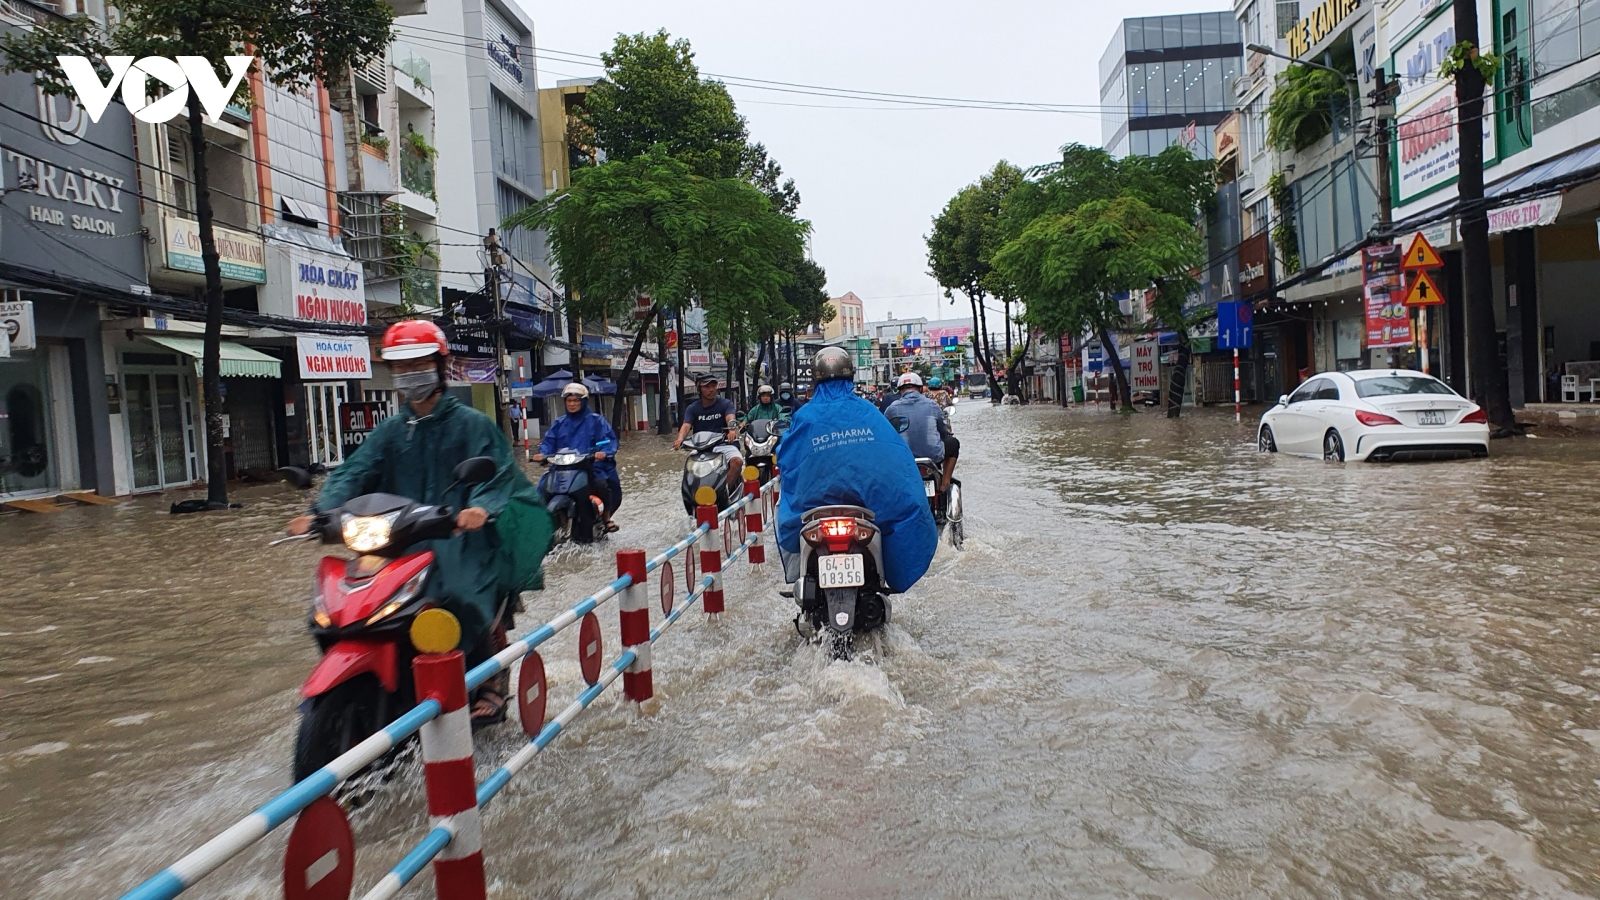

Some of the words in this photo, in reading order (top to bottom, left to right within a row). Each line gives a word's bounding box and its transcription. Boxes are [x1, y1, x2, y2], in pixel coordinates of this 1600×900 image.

[1284, 18, 1309, 63] THE
[1407, 41, 1432, 86] NỘI
[1433, 27, 1456, 66] TH
[7, 149, 124, 213] TRAKY
[30, 205, 65, 226] HAIR
[71, 214, 116, 236] SALON
[1521, 201, 1541, 221] TÍN
[327, 263, 359, 290] CHẤT
[0, 303, 24, 312] RAKY
[1382, 324, 1391, 343] 1
[333, 340, 353, 352] CHẤT
[1136, 345, 1153, 357] MÁY
[1137, 361, 1153, 374] TRỢ
[1134, 376, 1158, 388] THÍNH
[812, 434, 830, 446] DHG
[831, 427, 874, 441] PHARMA
[825, 557, 856, 571] 64-G1
[821, 570, 861, 587] 183.56
